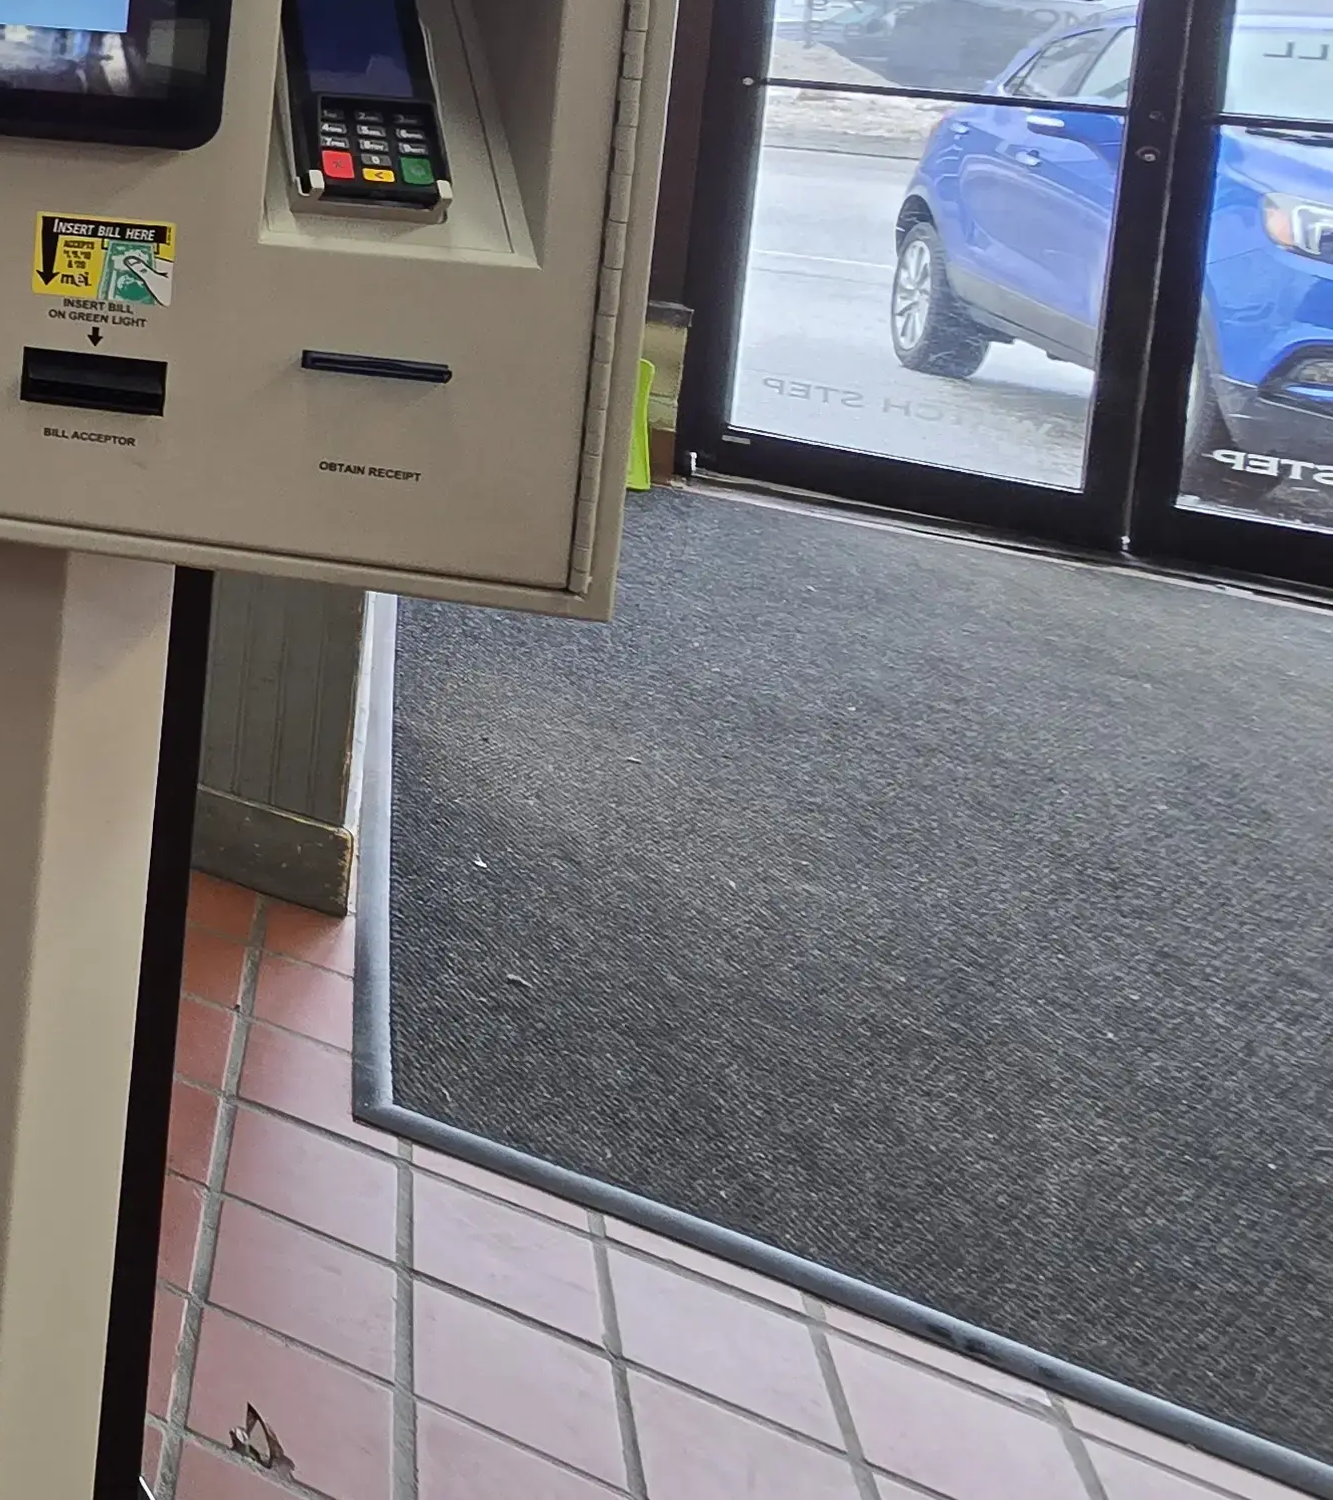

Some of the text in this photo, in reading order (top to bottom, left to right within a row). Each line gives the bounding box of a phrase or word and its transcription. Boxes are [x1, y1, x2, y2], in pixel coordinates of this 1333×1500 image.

[53, 218, 155, 241] INSERT BILL HERE
[63, 298, 133, 314] INSERT BILL
[48, 309, 147, 327] ON GREEN LIGHT
[43, 427, 136, 446] BILL ACCEPTOR
[319, 461, 422, 483] OBTAIN RECEIPT
